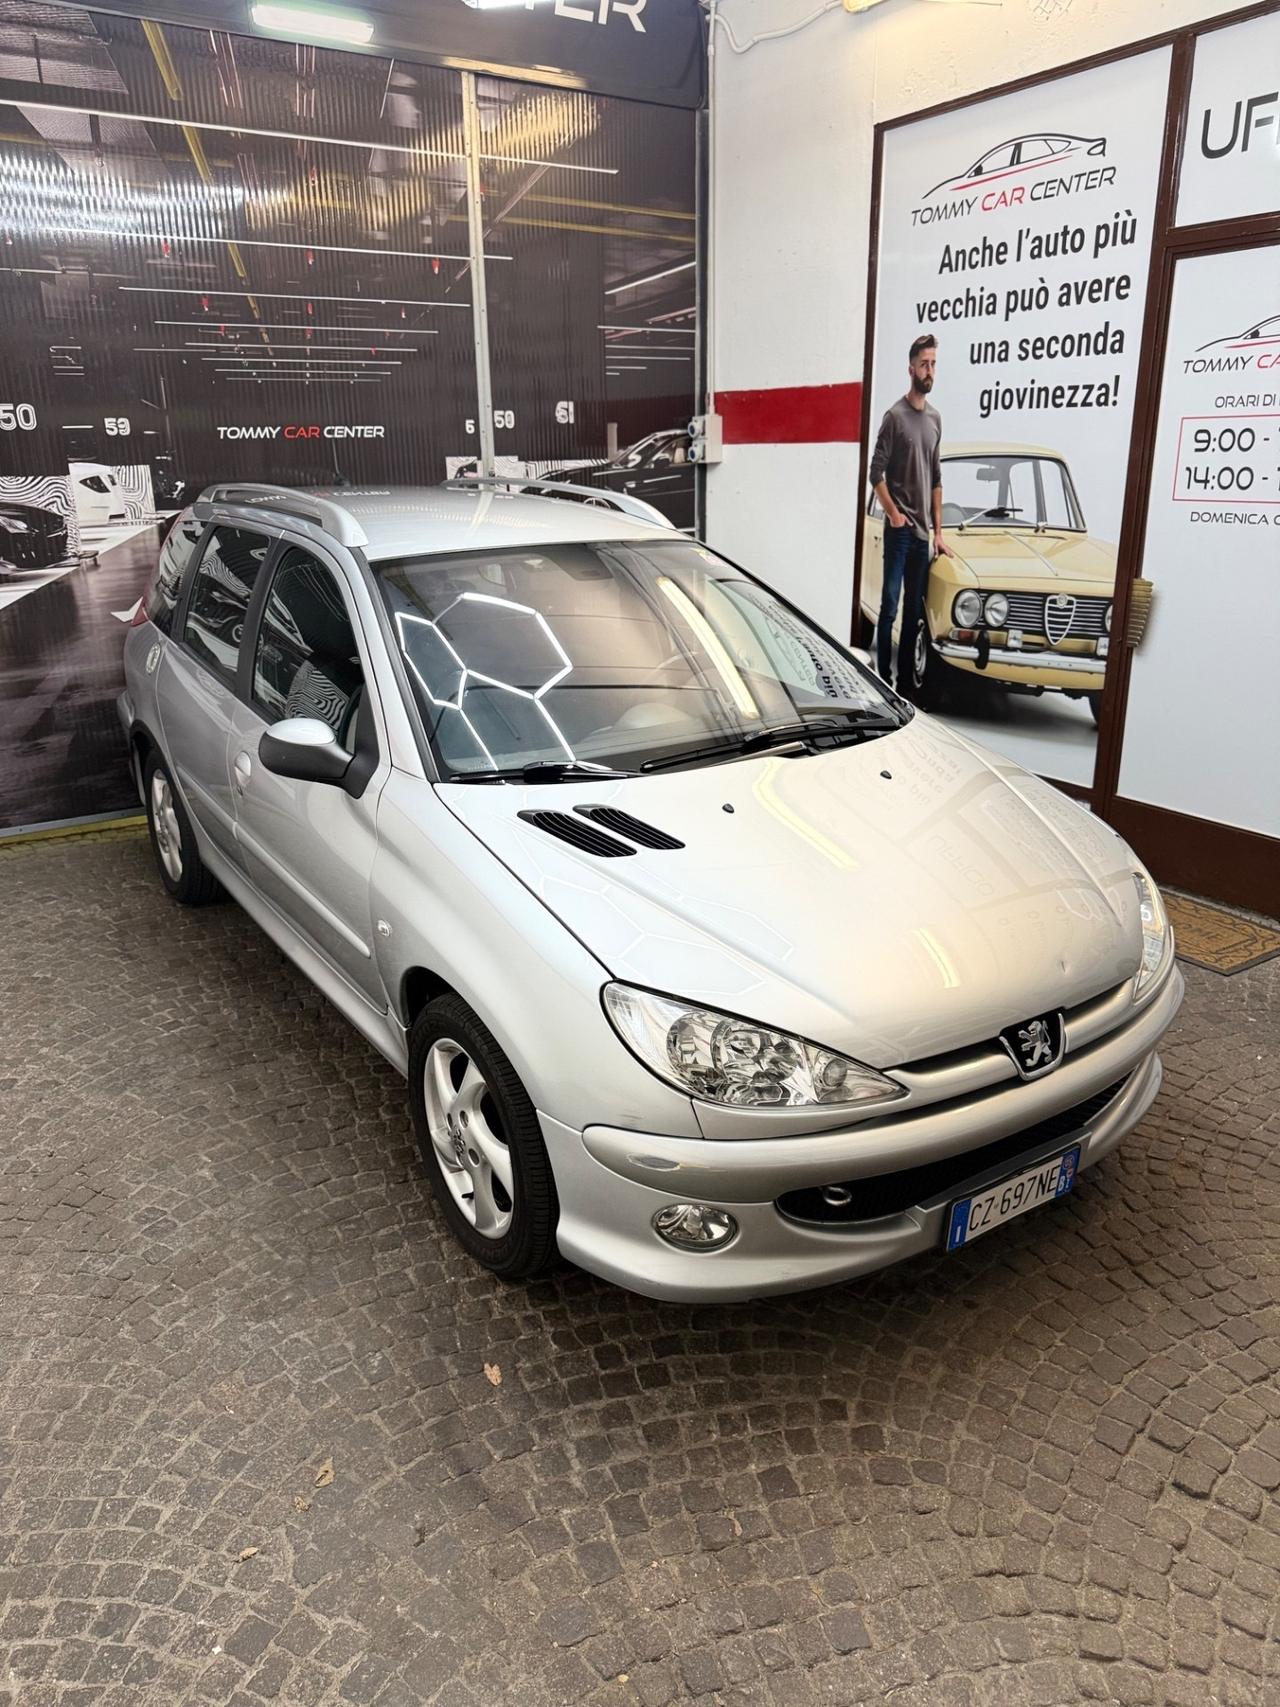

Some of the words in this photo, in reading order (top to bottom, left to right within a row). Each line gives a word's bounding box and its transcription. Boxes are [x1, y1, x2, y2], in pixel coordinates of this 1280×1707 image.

[1201, 91, 1280, 159] UF
[911, 196, 978, 226] TOMMY
[981, 186, 1025, 211] CAR
[1030, 166, 1117, 201] CENTER
[938, 236, 1008, 274] Anche
[1016, 228, 1085, 262] l'auto
[1093, 209, 1137, 258] più
[916, 286, 997, 323] vecchia
[1004, 277, 1049, 322] può
[1058, 274, 1131, 307] avere
[970, 340, 1009, 364] una
[1017, 321, 1125, 361] seconda
[1183, 355, 1254, 374] TOMMY
[979, 375, 1120, 419] giovinezza!
[1214, 394, 1260, 408] ORARI
[1263, 394, 1276, 406] DI
[217, 426, 281, 440] TOMMY
[284, 426, 320, 439] CAR
[324, 425, 385, 438] CENTER
[1194, 428, 1256, 453] 9:00
[1185, 466, 1254, 491] 14:00
[1190, 511, 1269, 526] DOMENICA
[969, 1196, 996, 1231] CZ
[1000, 1164, 1061, 1215] 697NE
